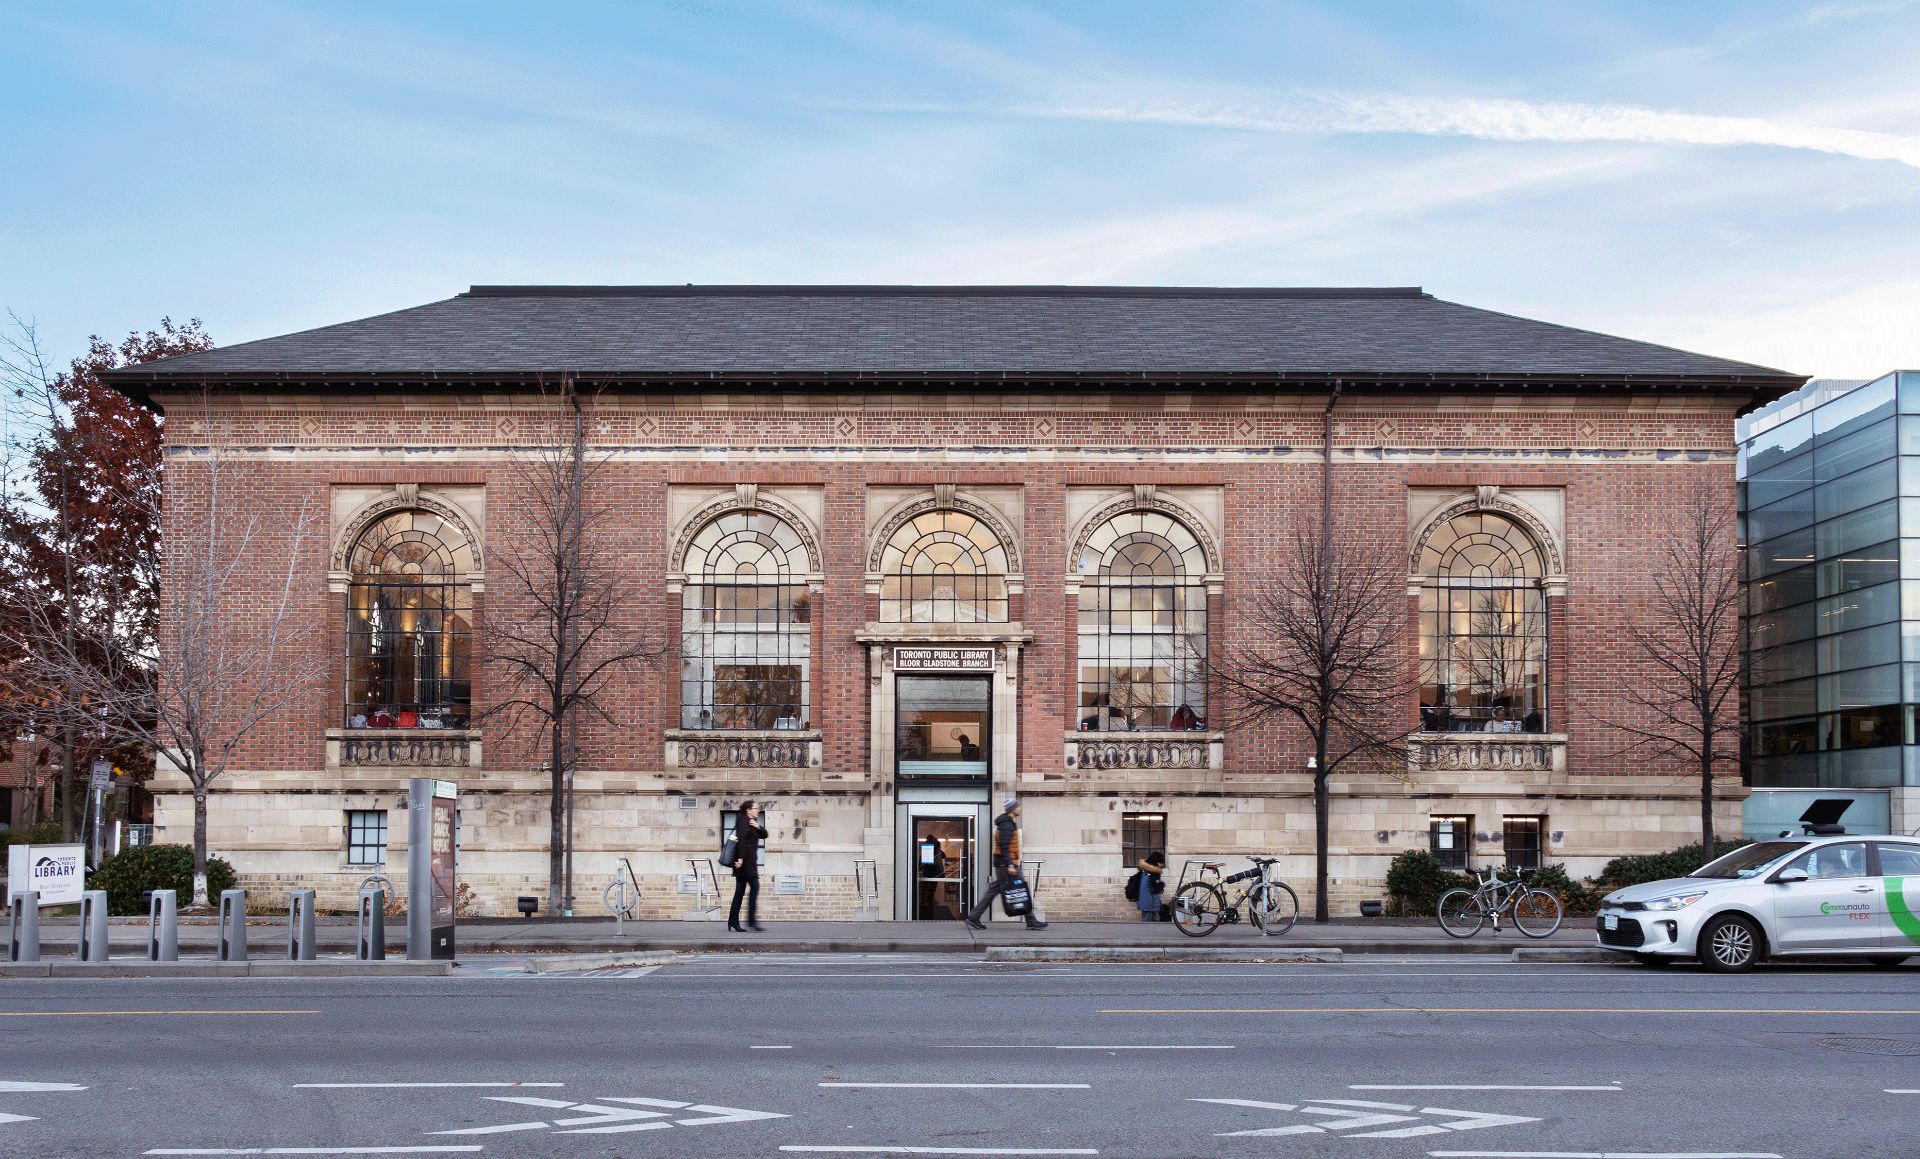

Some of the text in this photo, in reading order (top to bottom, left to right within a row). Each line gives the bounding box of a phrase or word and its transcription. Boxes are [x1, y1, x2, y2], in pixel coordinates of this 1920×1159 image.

[900, 651, 988, 659] TORONTO PUBLIC LIBRARY
[35, 866, 76, 877] LIBRARY
